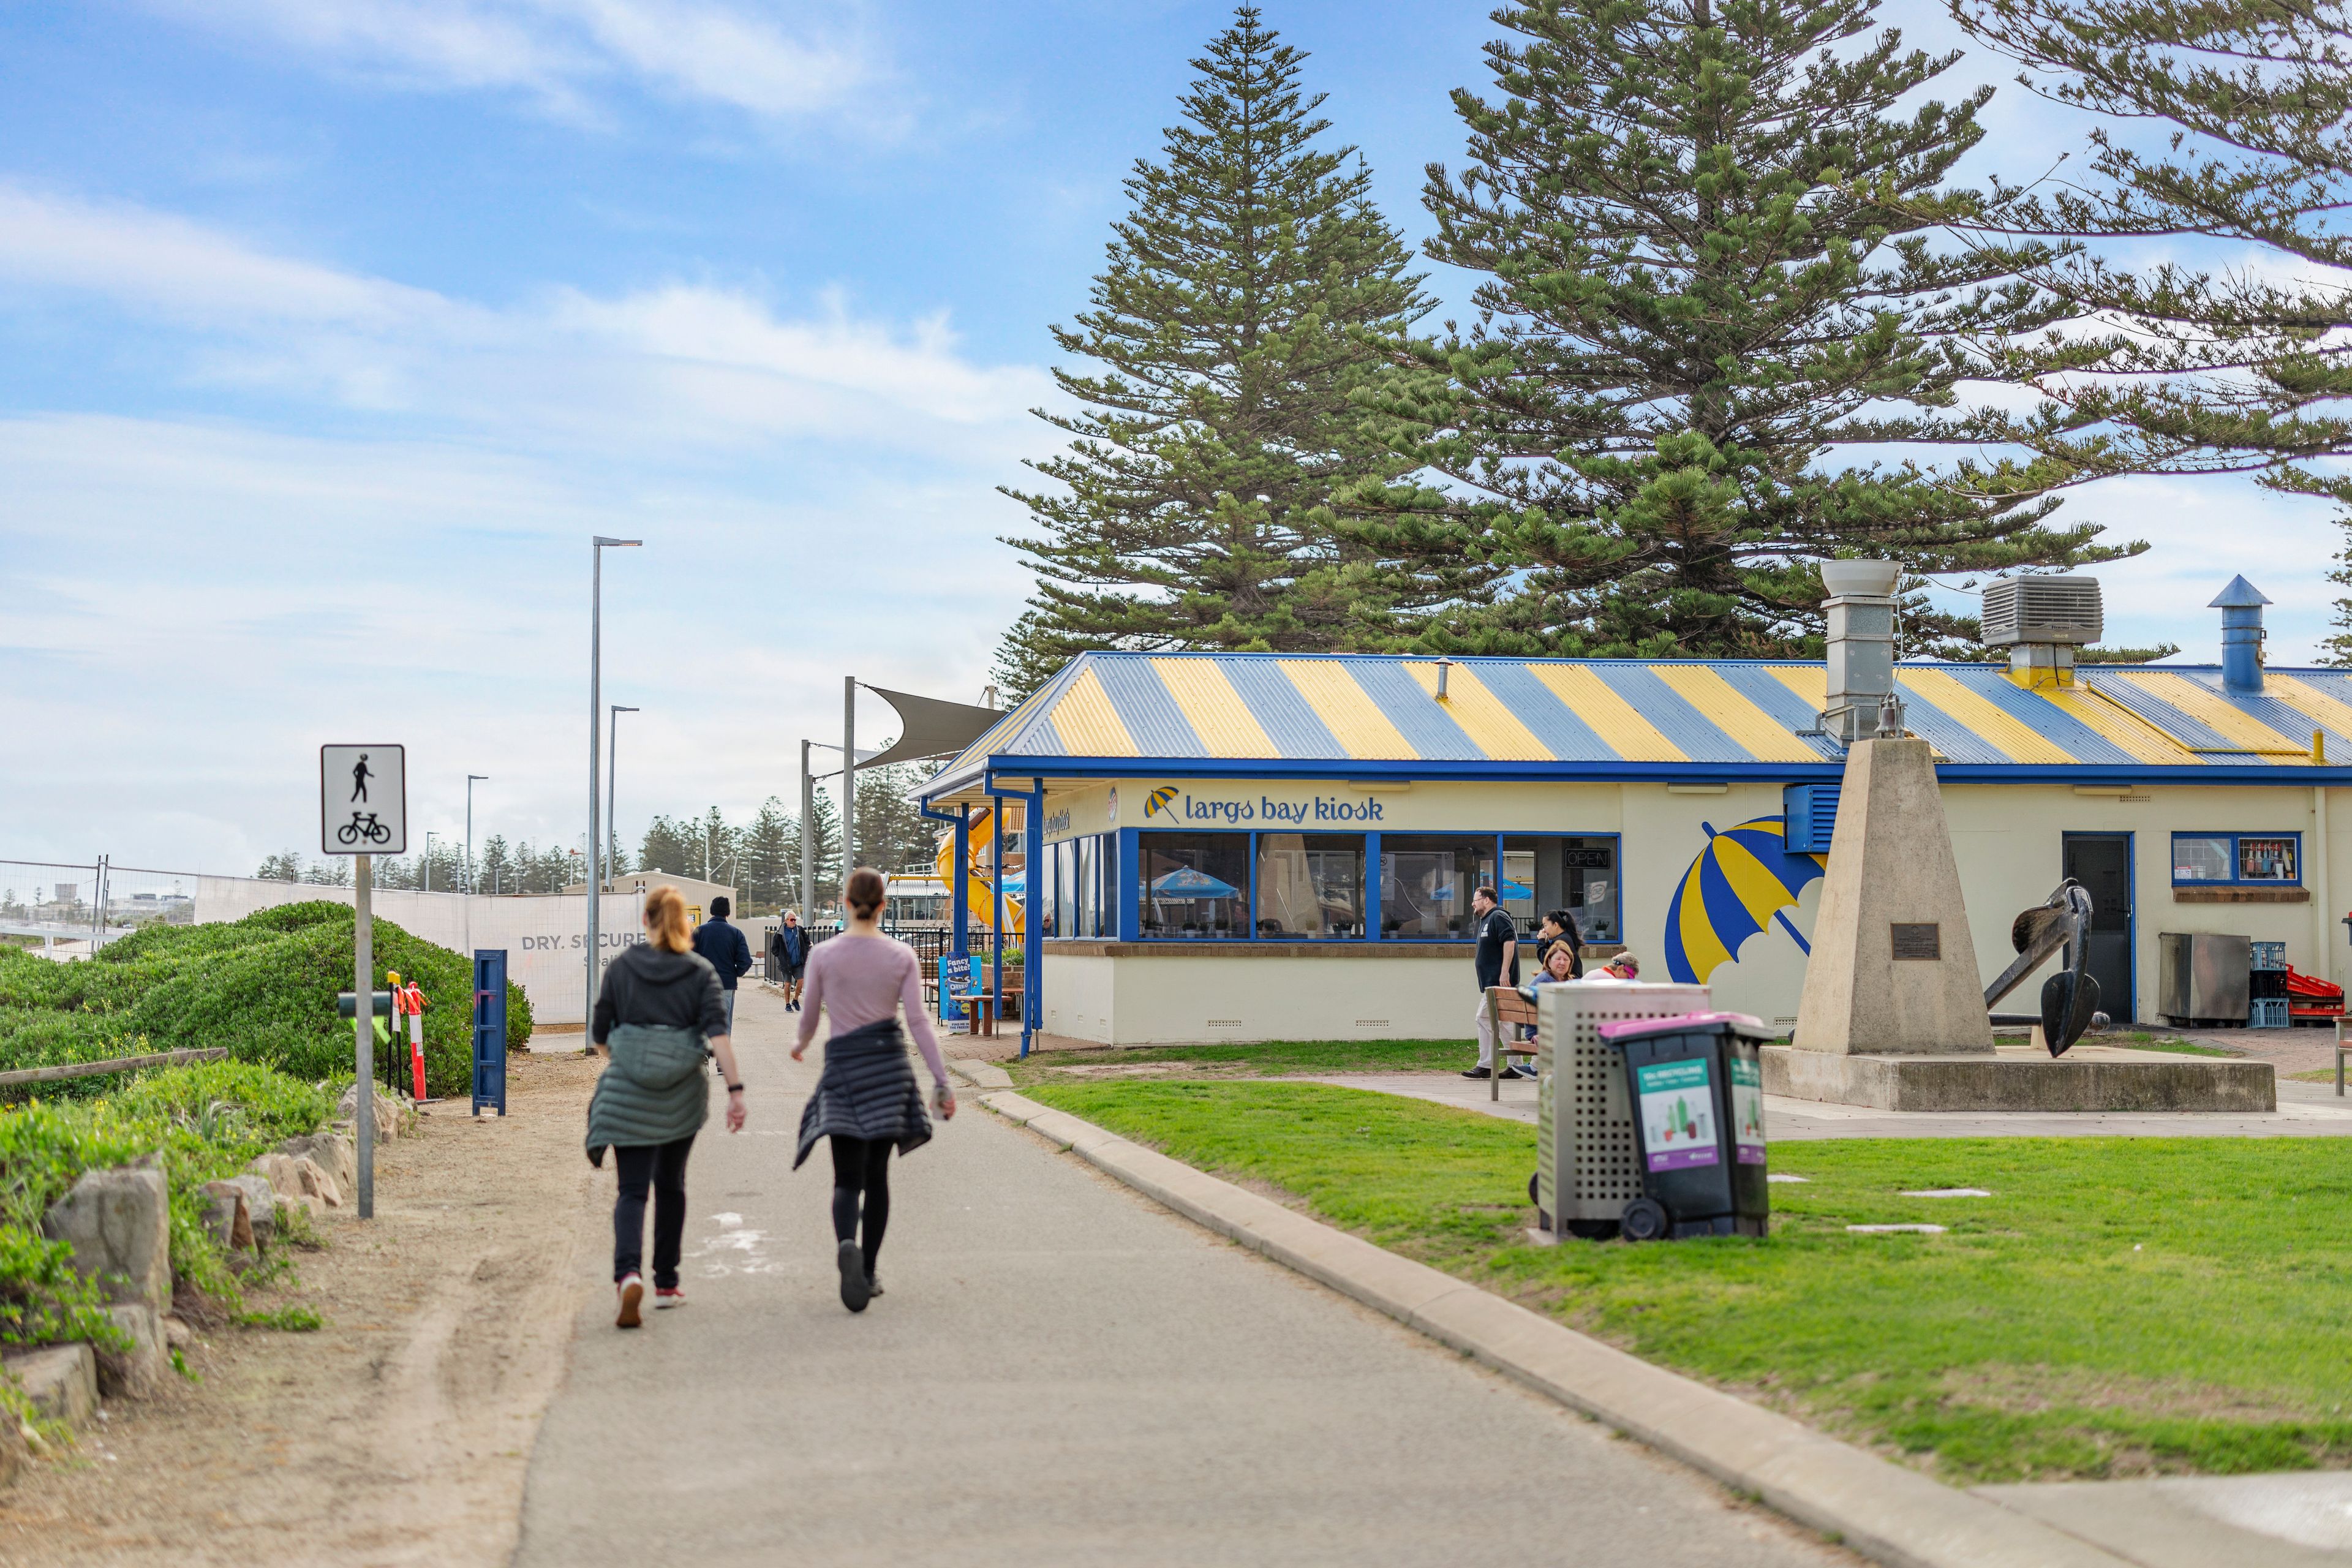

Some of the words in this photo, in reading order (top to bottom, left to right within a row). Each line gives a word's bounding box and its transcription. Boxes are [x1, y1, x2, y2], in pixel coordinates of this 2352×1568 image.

[1186, 795, 1254, 824] largs
[1262, 796, 1309, 824] bay
[1315, 797, 1384, 821] kiosk
[1568, 852, 1607, 865] OPEN
[522, 935, 565, 950] DRY.
[947, 958, 968, 967] Fancy
[953, 963, 970, 973] bite?
